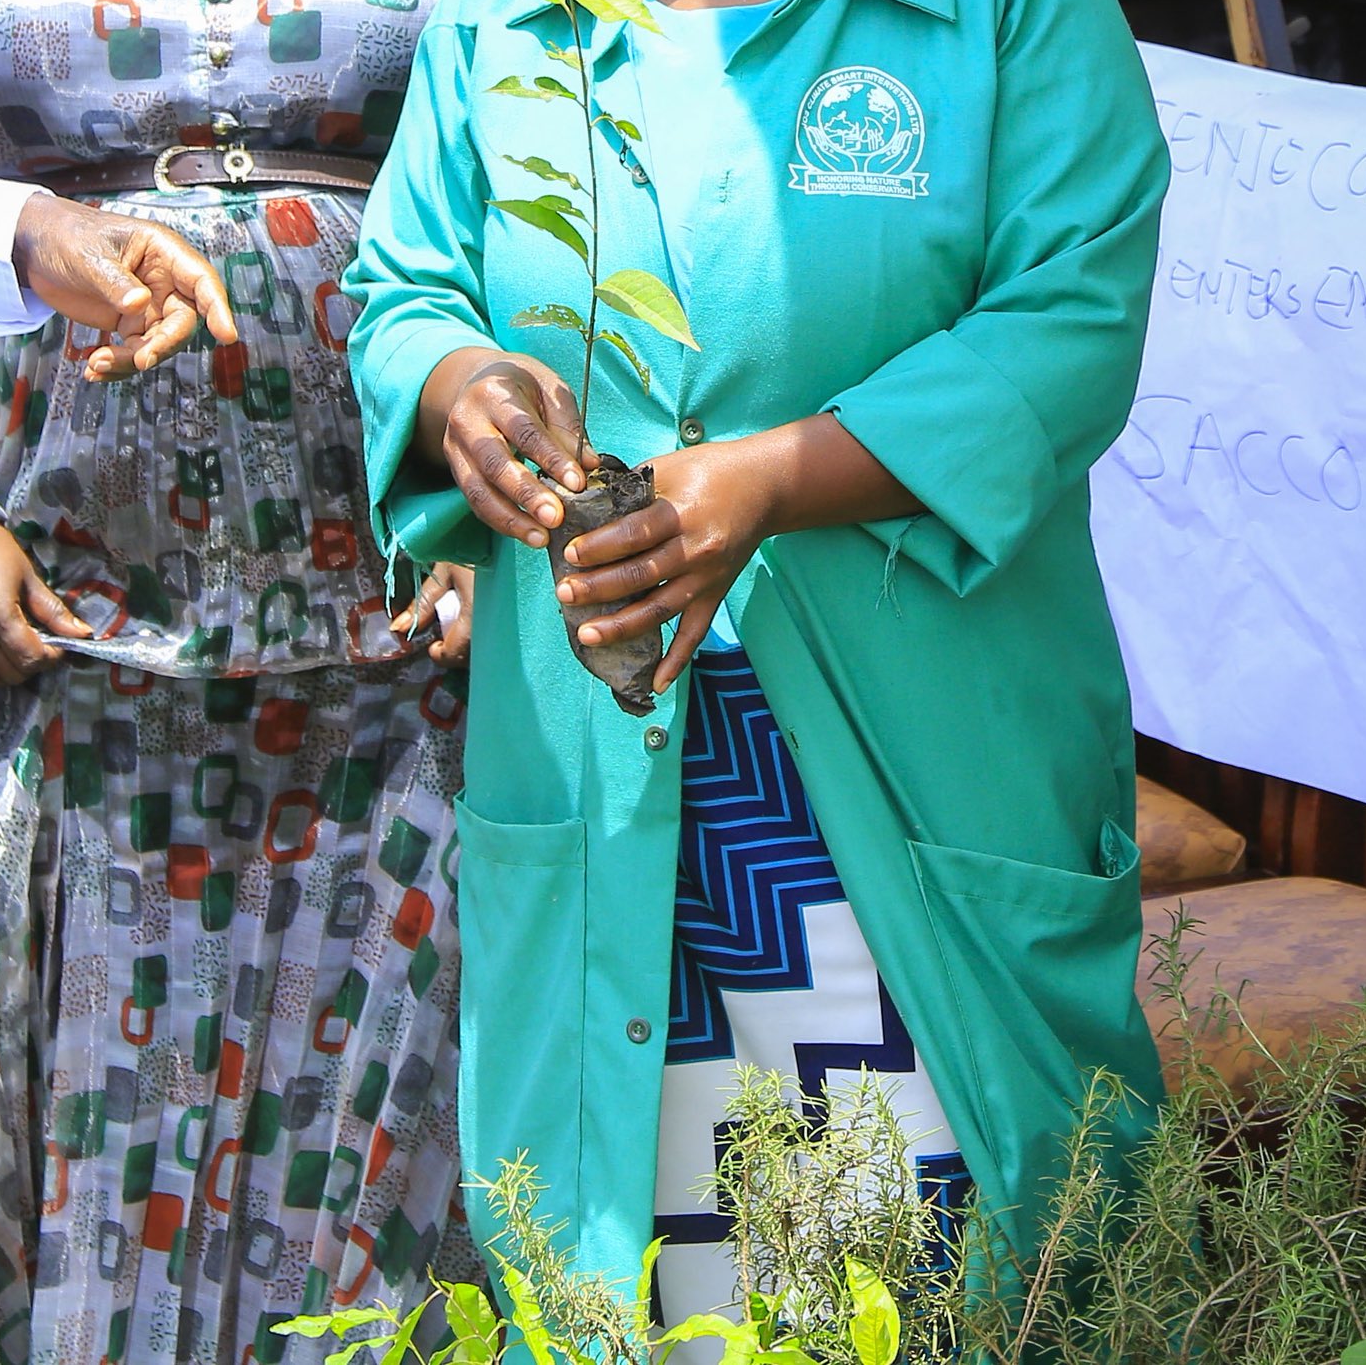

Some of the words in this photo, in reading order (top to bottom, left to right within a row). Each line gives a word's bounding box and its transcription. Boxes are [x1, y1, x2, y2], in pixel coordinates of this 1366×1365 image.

[830, 71, 864, 86] SMART
[816, 174, 865, 185] HONORING
[865, 175, 901, 186] NATURE
[1127, 395, 1363, 511] SACCO
